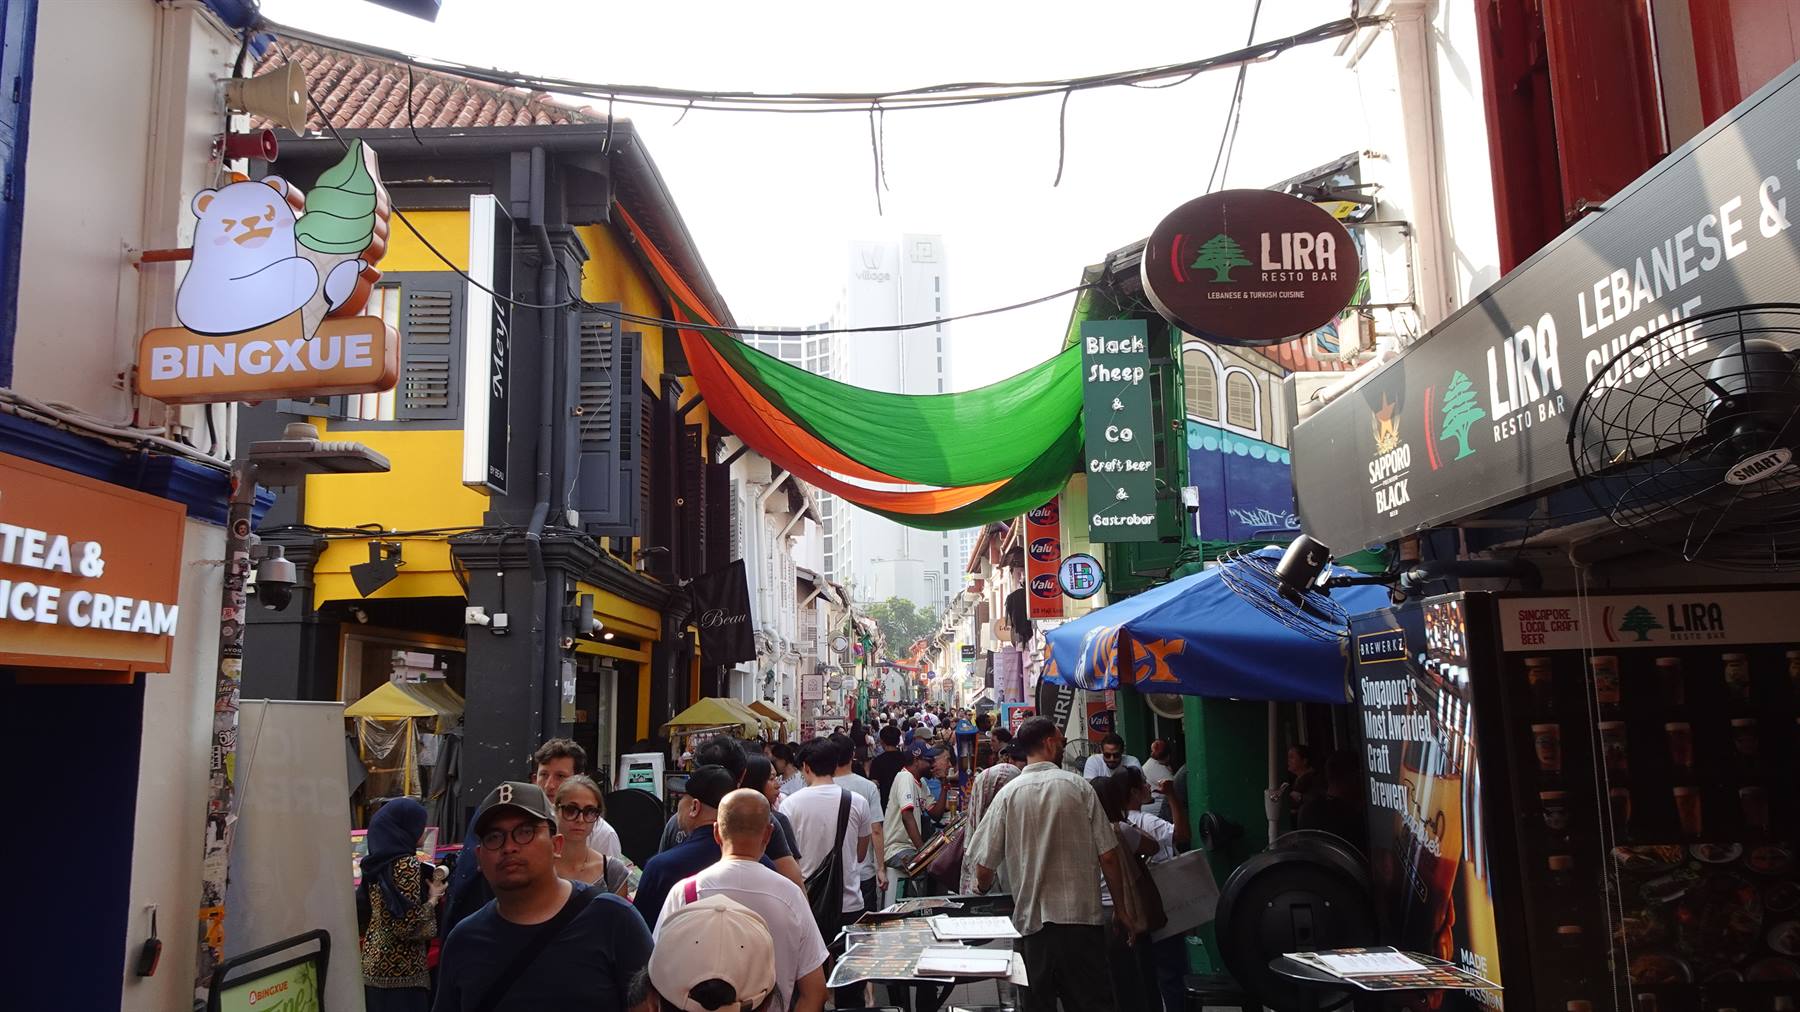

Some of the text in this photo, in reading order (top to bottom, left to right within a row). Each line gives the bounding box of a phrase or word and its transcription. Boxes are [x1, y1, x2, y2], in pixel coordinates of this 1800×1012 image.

[1260, 231, 1337, 271] LIRA
[1578, 175, 1792, 339] LEBANESE &
[1262, 271, 1337, 281] RESTO BAR
[1207, 290, 1305, 299] LEBANESE & TURKISH CUISINE
[151, 334, 373, 381] BINGXUE
[1086, 336, 1144, 354] Black
[1585, 295, 1709, 399] CUISINE
[1088, 364, 1144, 385] Sheep
[1486, 312, 1562, 421] LIRA
[1111, 398, 1124, 411] &
[1493, 395, 1565, 443] RESTO BAR
[1105, 425, 1133, 443] Co
[1090, 458, 1152, 472] Craft Beer
[1368, 443, 1411, 484] SAPPORO
[1733, 453, 1782, 480] SMART
[1115, 487, 1129, 500] &
[1375, 479, 1410, 514] BLACK
[1093, 513, 1155, 526] Gastrobar
[0, 523, 105, 578] TEA &
[0, 579, 179, 637] ICE CREAM
[701, 608, 747, 631] Beau
[1518, 608, 1571, 621] SINGAPORE
[1667, 602, 1724, 633] LIRA
[1520, 620, 1579, 633] LOCAL CRAFT
[1521, 633, 1545, 645] BEER
[1360, 637, 1404, 656] BREWERKZ
[1361, 674, 1418, 710] Singapore's
[1364, 710, 1432, 742] Most Awarded
[1367, 743, 1391, 774] Craft
[498, 784, 513, 805] B
[1370, 777, 1408, 815] Brewery
[1461, 947, 1488, 979] MADE
[255, 980, 289, 1001] BINGXUE
